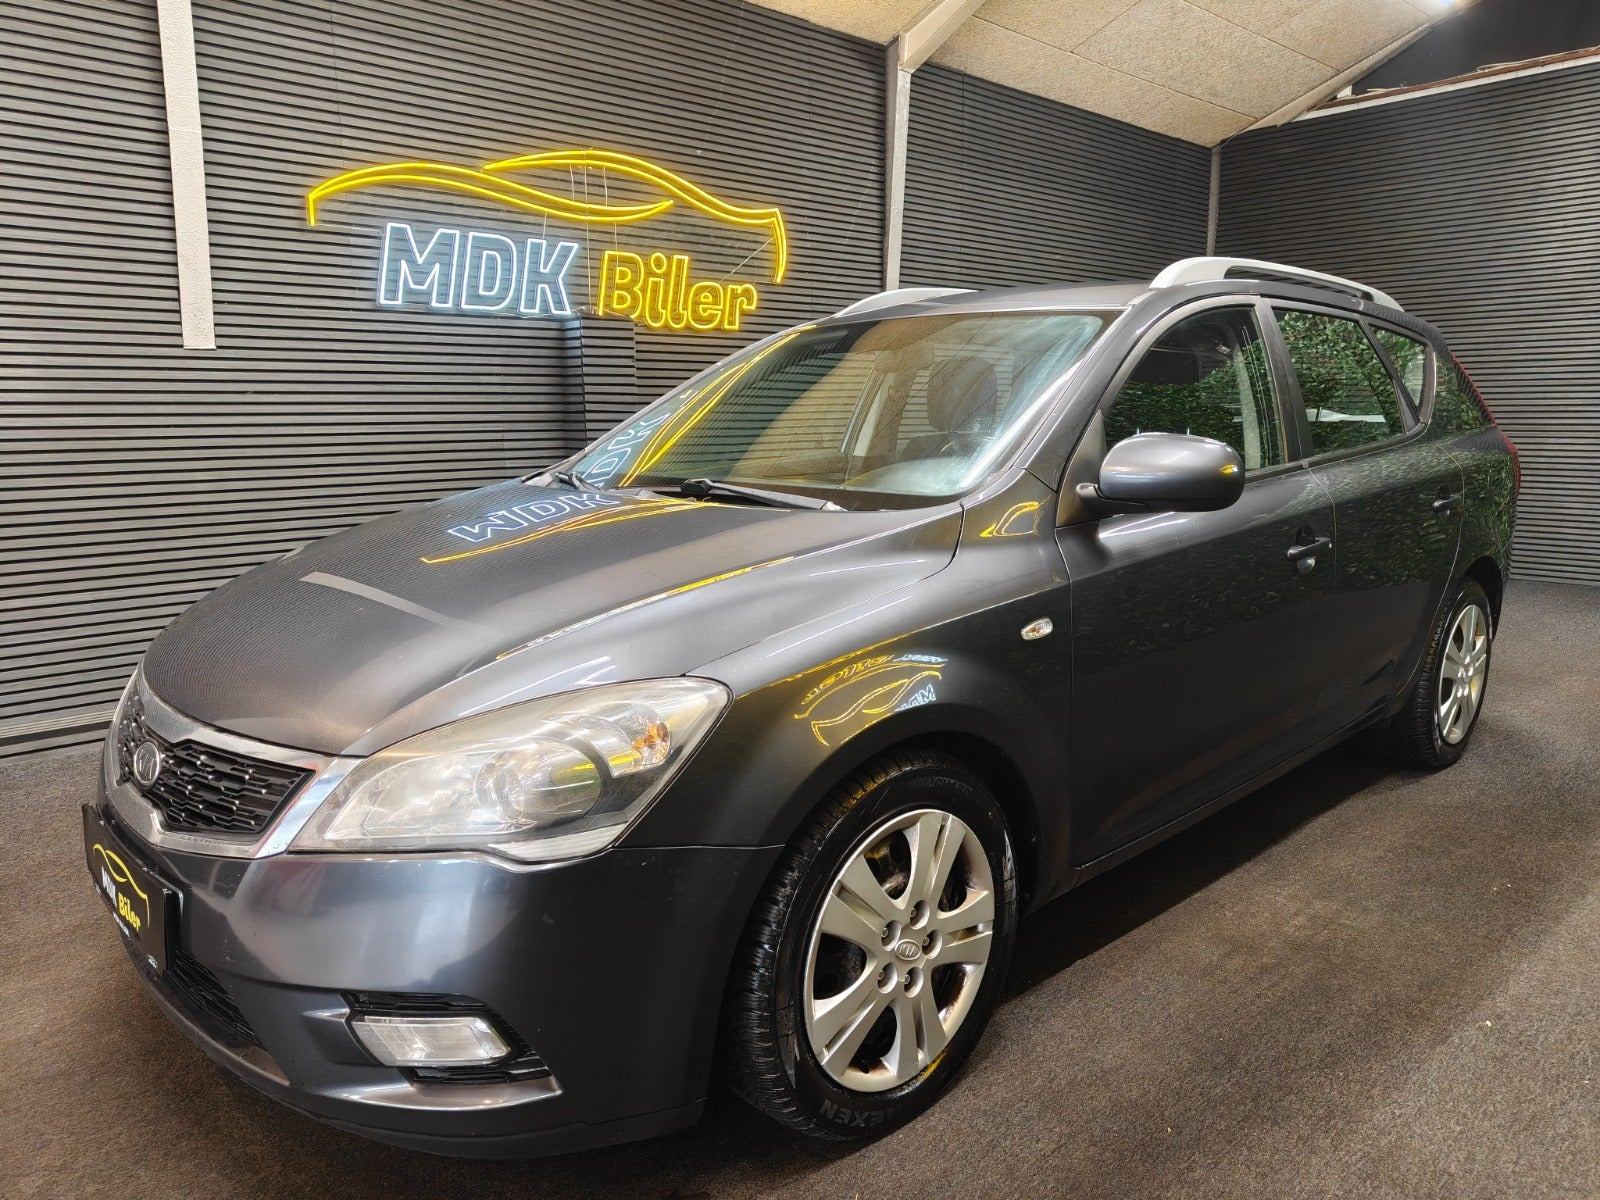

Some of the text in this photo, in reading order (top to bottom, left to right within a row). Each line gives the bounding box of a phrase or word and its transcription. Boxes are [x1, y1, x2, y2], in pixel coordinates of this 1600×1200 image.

[376, 221, 758, 331] MDK Biler
[118, 891, 141, 932] Biler
